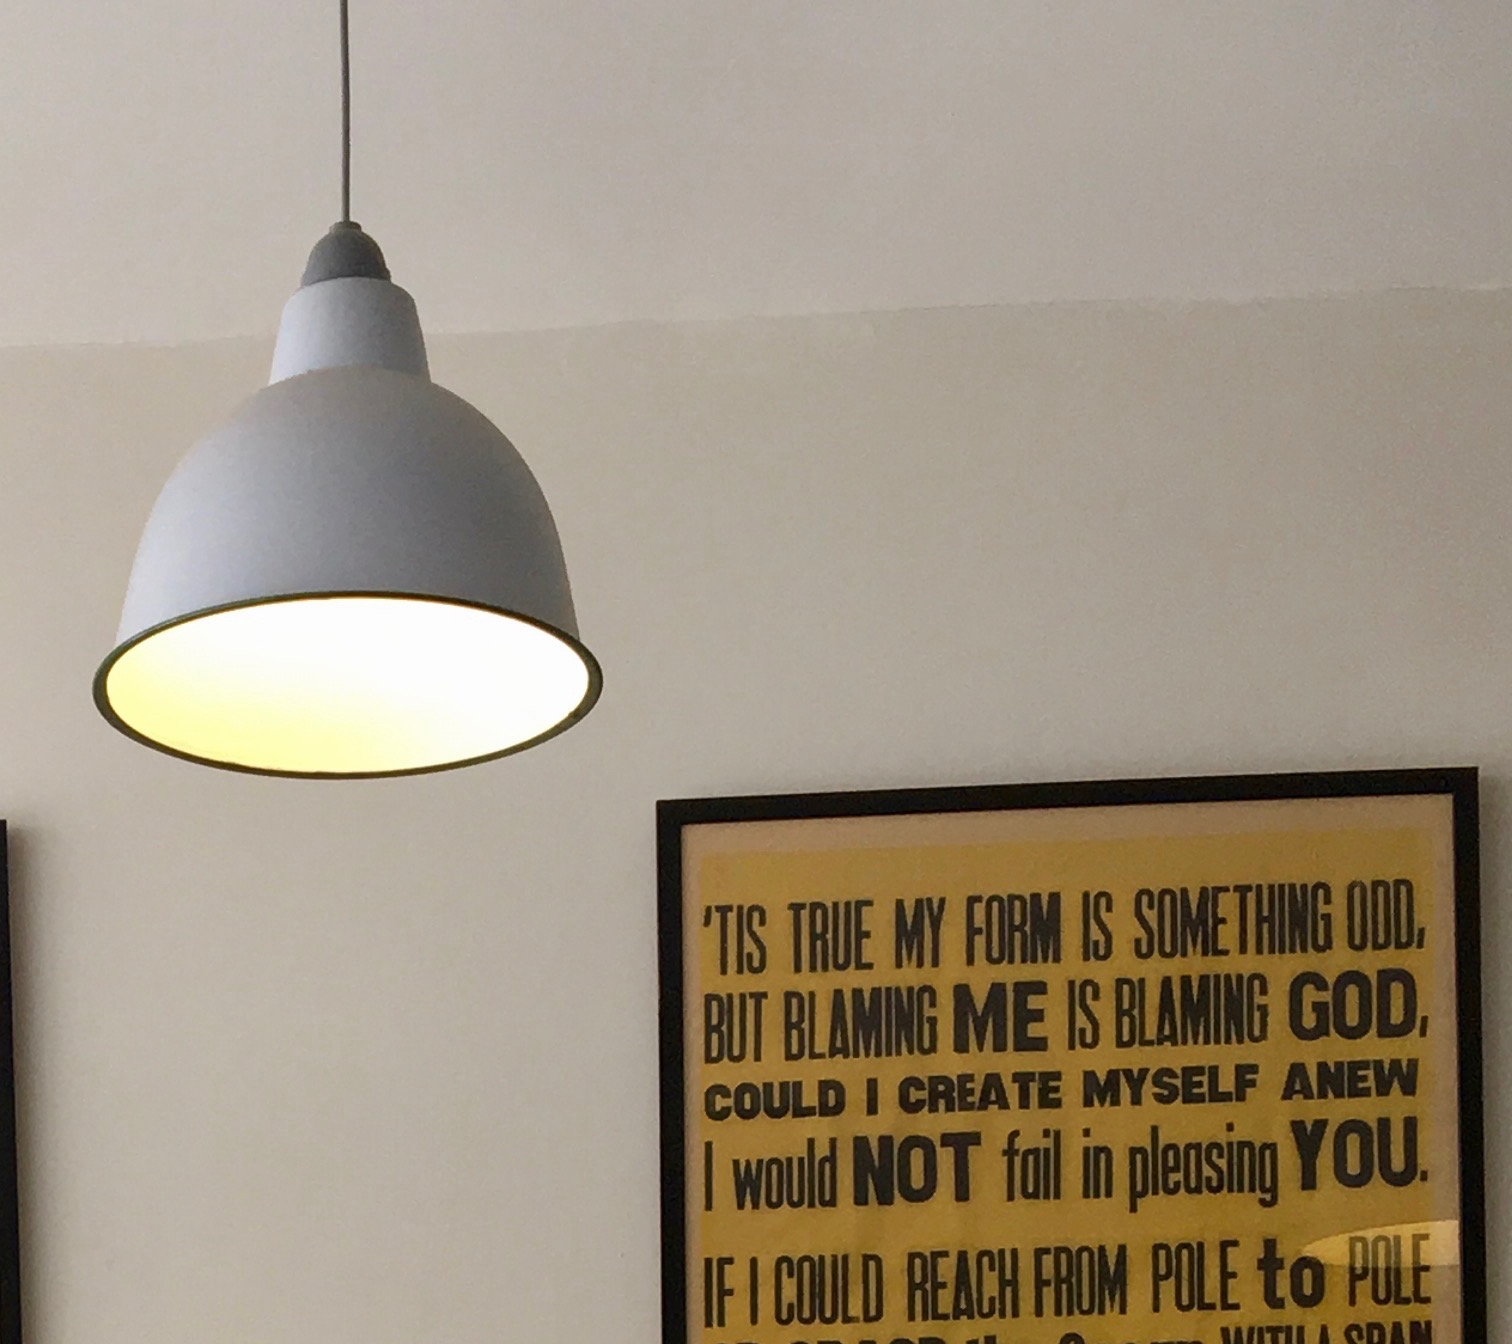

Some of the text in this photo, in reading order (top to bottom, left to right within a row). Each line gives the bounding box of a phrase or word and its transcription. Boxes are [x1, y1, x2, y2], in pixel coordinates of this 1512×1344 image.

[702, 878, 1426, 976] 'TIS TRUE MY FORM IS SOMETHING ODD,
[703, 967, 1429, 1065] BUT BLAMING ME IS BLAMING GOD,
[704, 1057, 1420, 1122] COULD I CREATE MYSELF ANEW
[704, 1115, 1429, 1214] I would NOT fail in pleasing YOU.
[703, 1233, 1432, 1329] IF I COULD REACH FROM POLE to POLE
